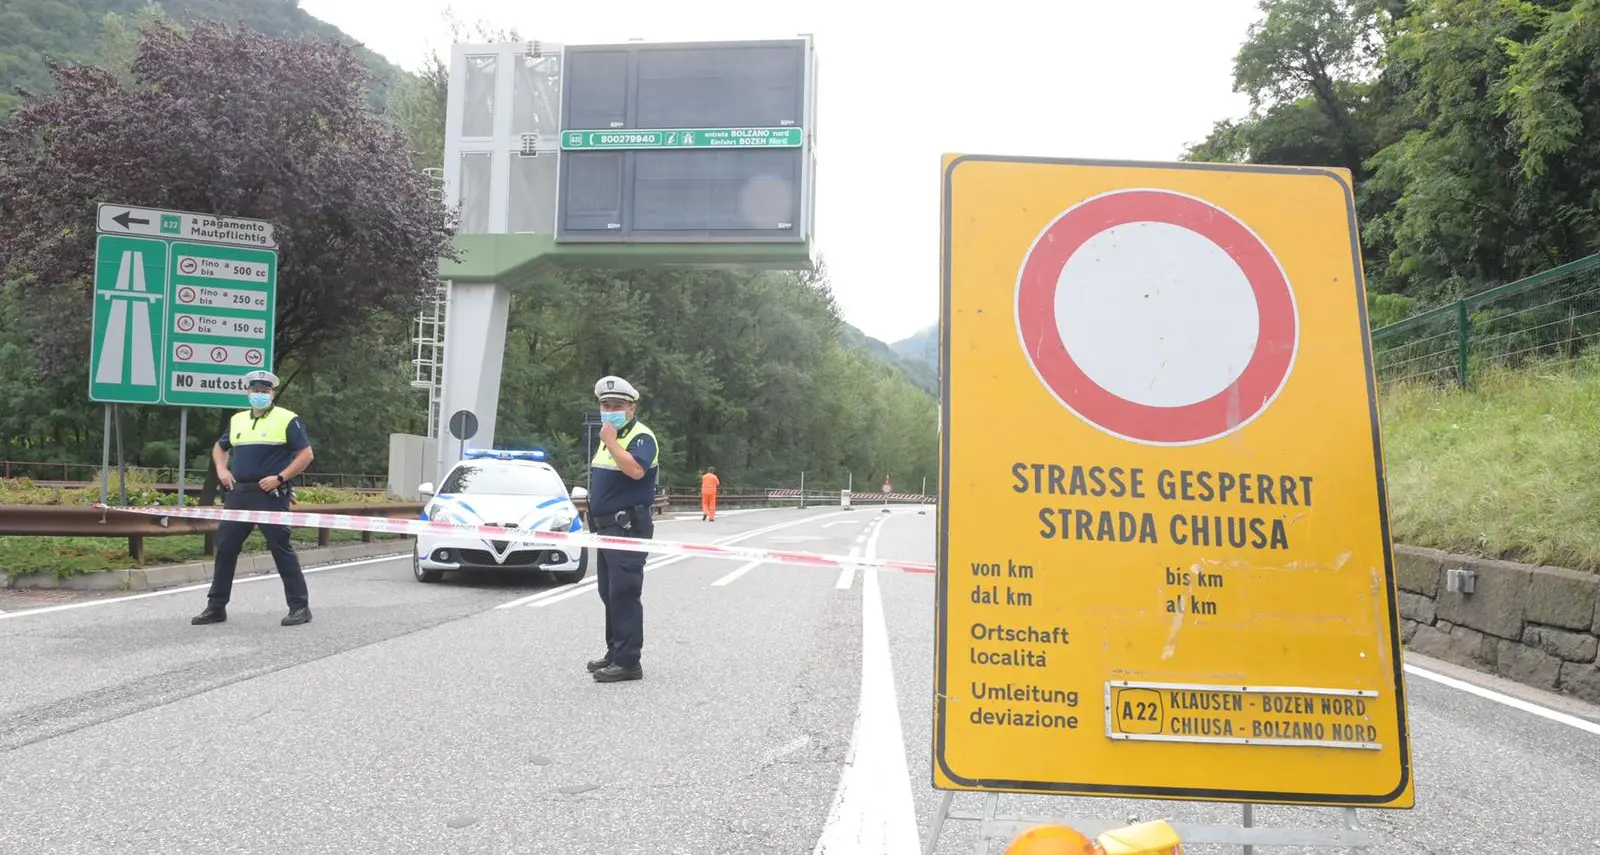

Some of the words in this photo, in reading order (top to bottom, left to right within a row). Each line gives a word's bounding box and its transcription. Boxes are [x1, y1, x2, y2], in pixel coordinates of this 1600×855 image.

[601, 135, 655, 143] 800279940
[163, 220, 178, 229] A22
[203, 218, 264, 232] pagamento
[191, 226, 267, 244] Mautpflichtig
[201, 258, 220, 268] fino
[201, 268, 214, 276] bis
[233, 266, 252, 276] 500
[200, 288, 218, 297] fino
[232, 295, 250, 304] 250
[199, 317, 216, 325] fino
[233, 323, 250, 332] 150
[176, 374, 194, 388] NO
[1011, 462, 1146, 499] STRASSE
[1157, 469, 1314, 507] GESPERRT
[1039, 507, 1158, 544] STRADA
[1170, 513, 1289, 550] CHIUSA
[971, 562, 1001, 578] von
[1008, 559, 1034, 579] km
[1166, 567, 1191, 586] bis
[1197, 568, 1224, 588] km
[970, 584, 999, 605] dal
[1006, 587, 1032, 606] km
[1166, 595, 1185, 614] al
[1191, 596, 1217, 615] km
[970, 623, 1070, 645] Ortschaft
[970, 647, 1047, 668] località
[970, 682, 1078, 708] Umleitung
[1170, 691, 1242, 712] KLAUSEN
[1262, 695, 1314, 715] BOZEN
[1321, 698, 1366, 716] NORD
[970, 707, 1078, 729] deviazione
[1122, 701, 1158, 722] A22
[1170, 716, 1233, 736] CHIUSA
[1252, 720, 1324, 740] BOLZANO
[1332, 723, 1377, 742] NORD
